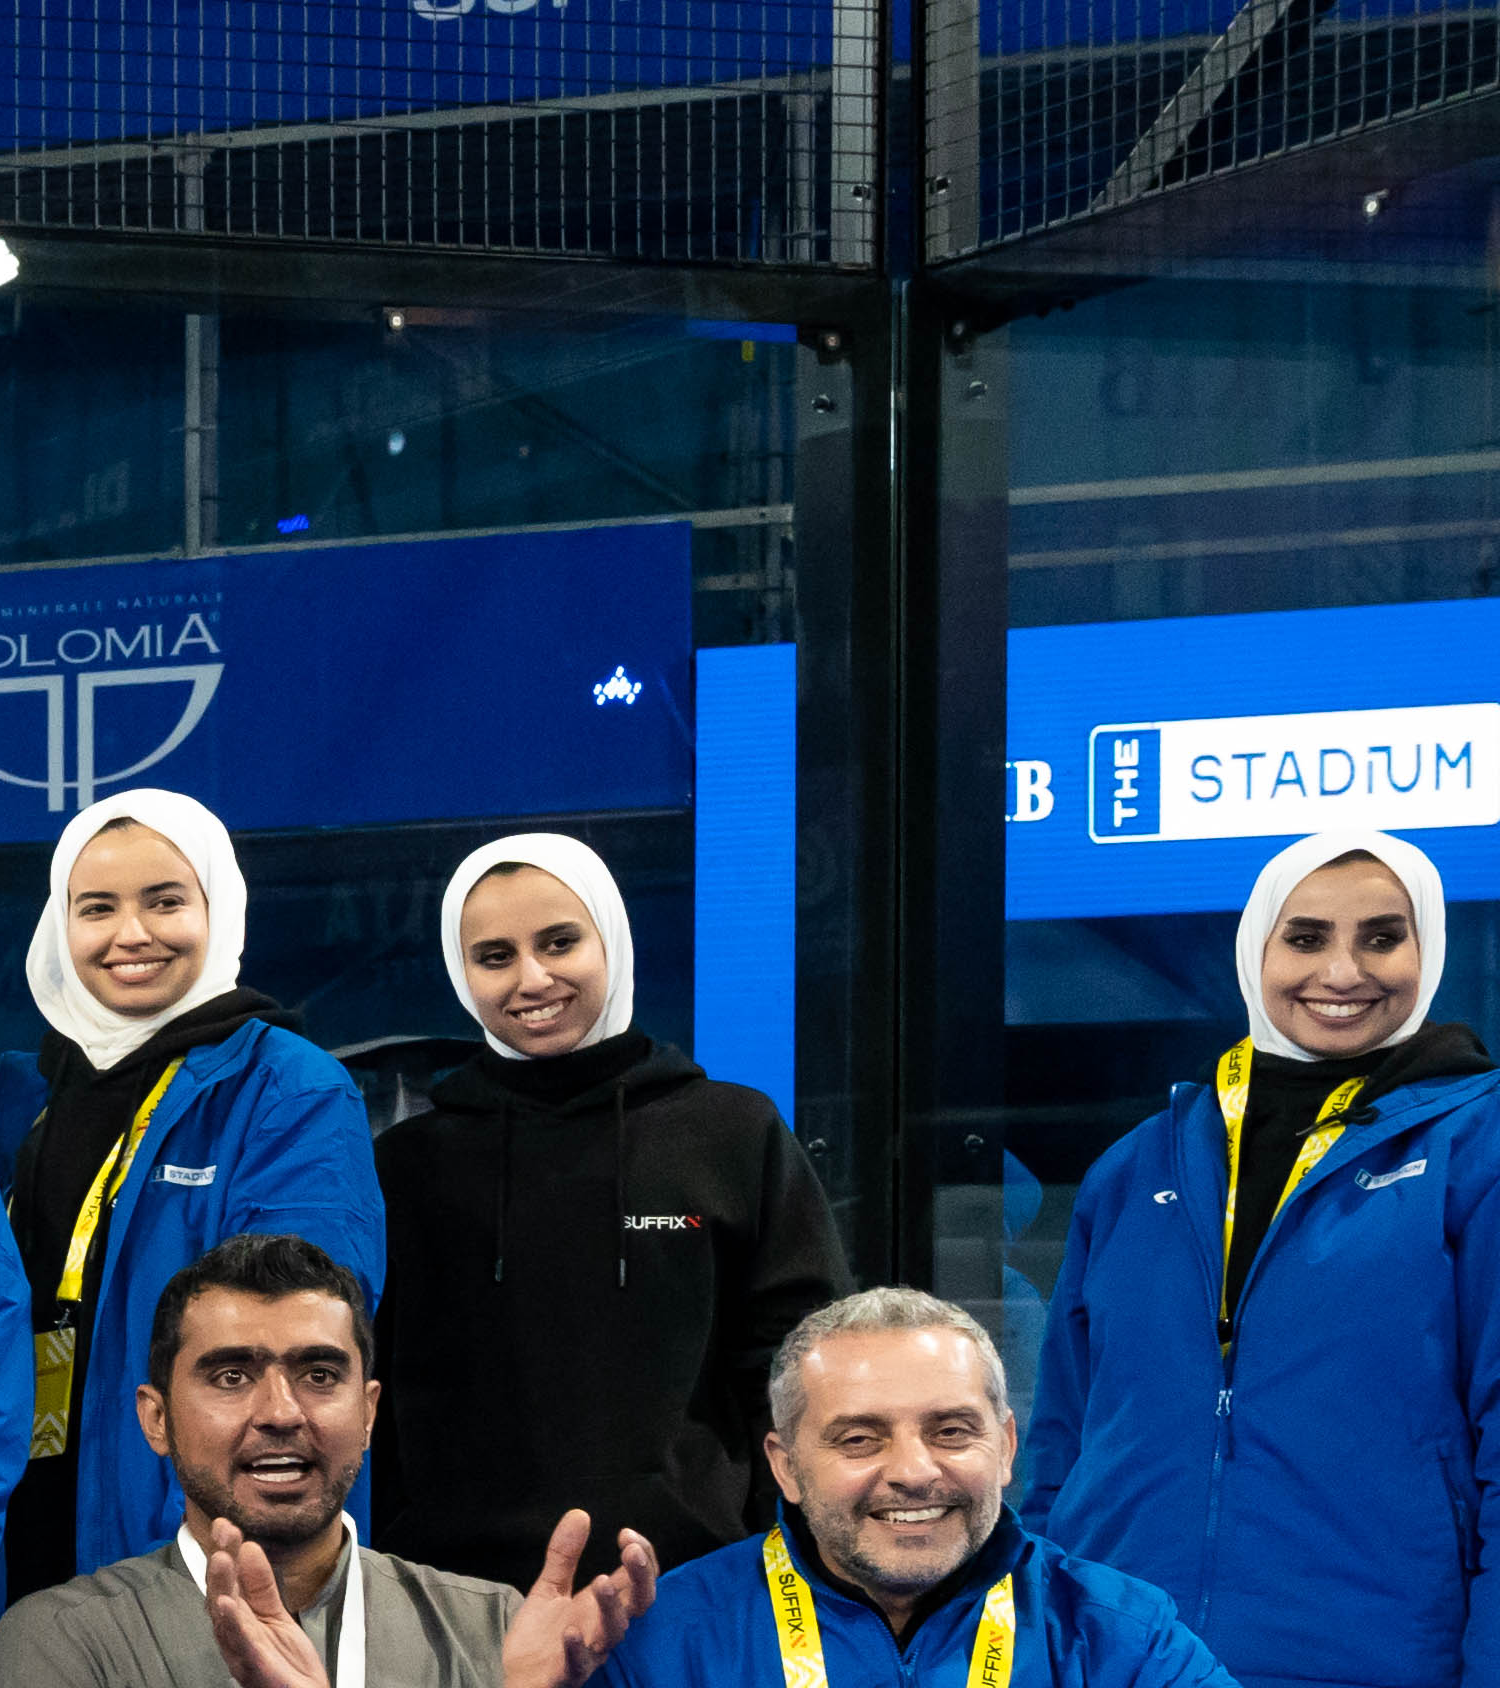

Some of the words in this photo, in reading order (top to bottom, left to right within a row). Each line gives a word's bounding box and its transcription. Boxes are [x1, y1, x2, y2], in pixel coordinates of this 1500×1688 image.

[2, 600, 103, 618] MINERALE
[1113, 738, 1139, 828] THE
[1189, 741, 1473, 803] STADIUM
[778, 1572, 805, 1634] SUFFIX
